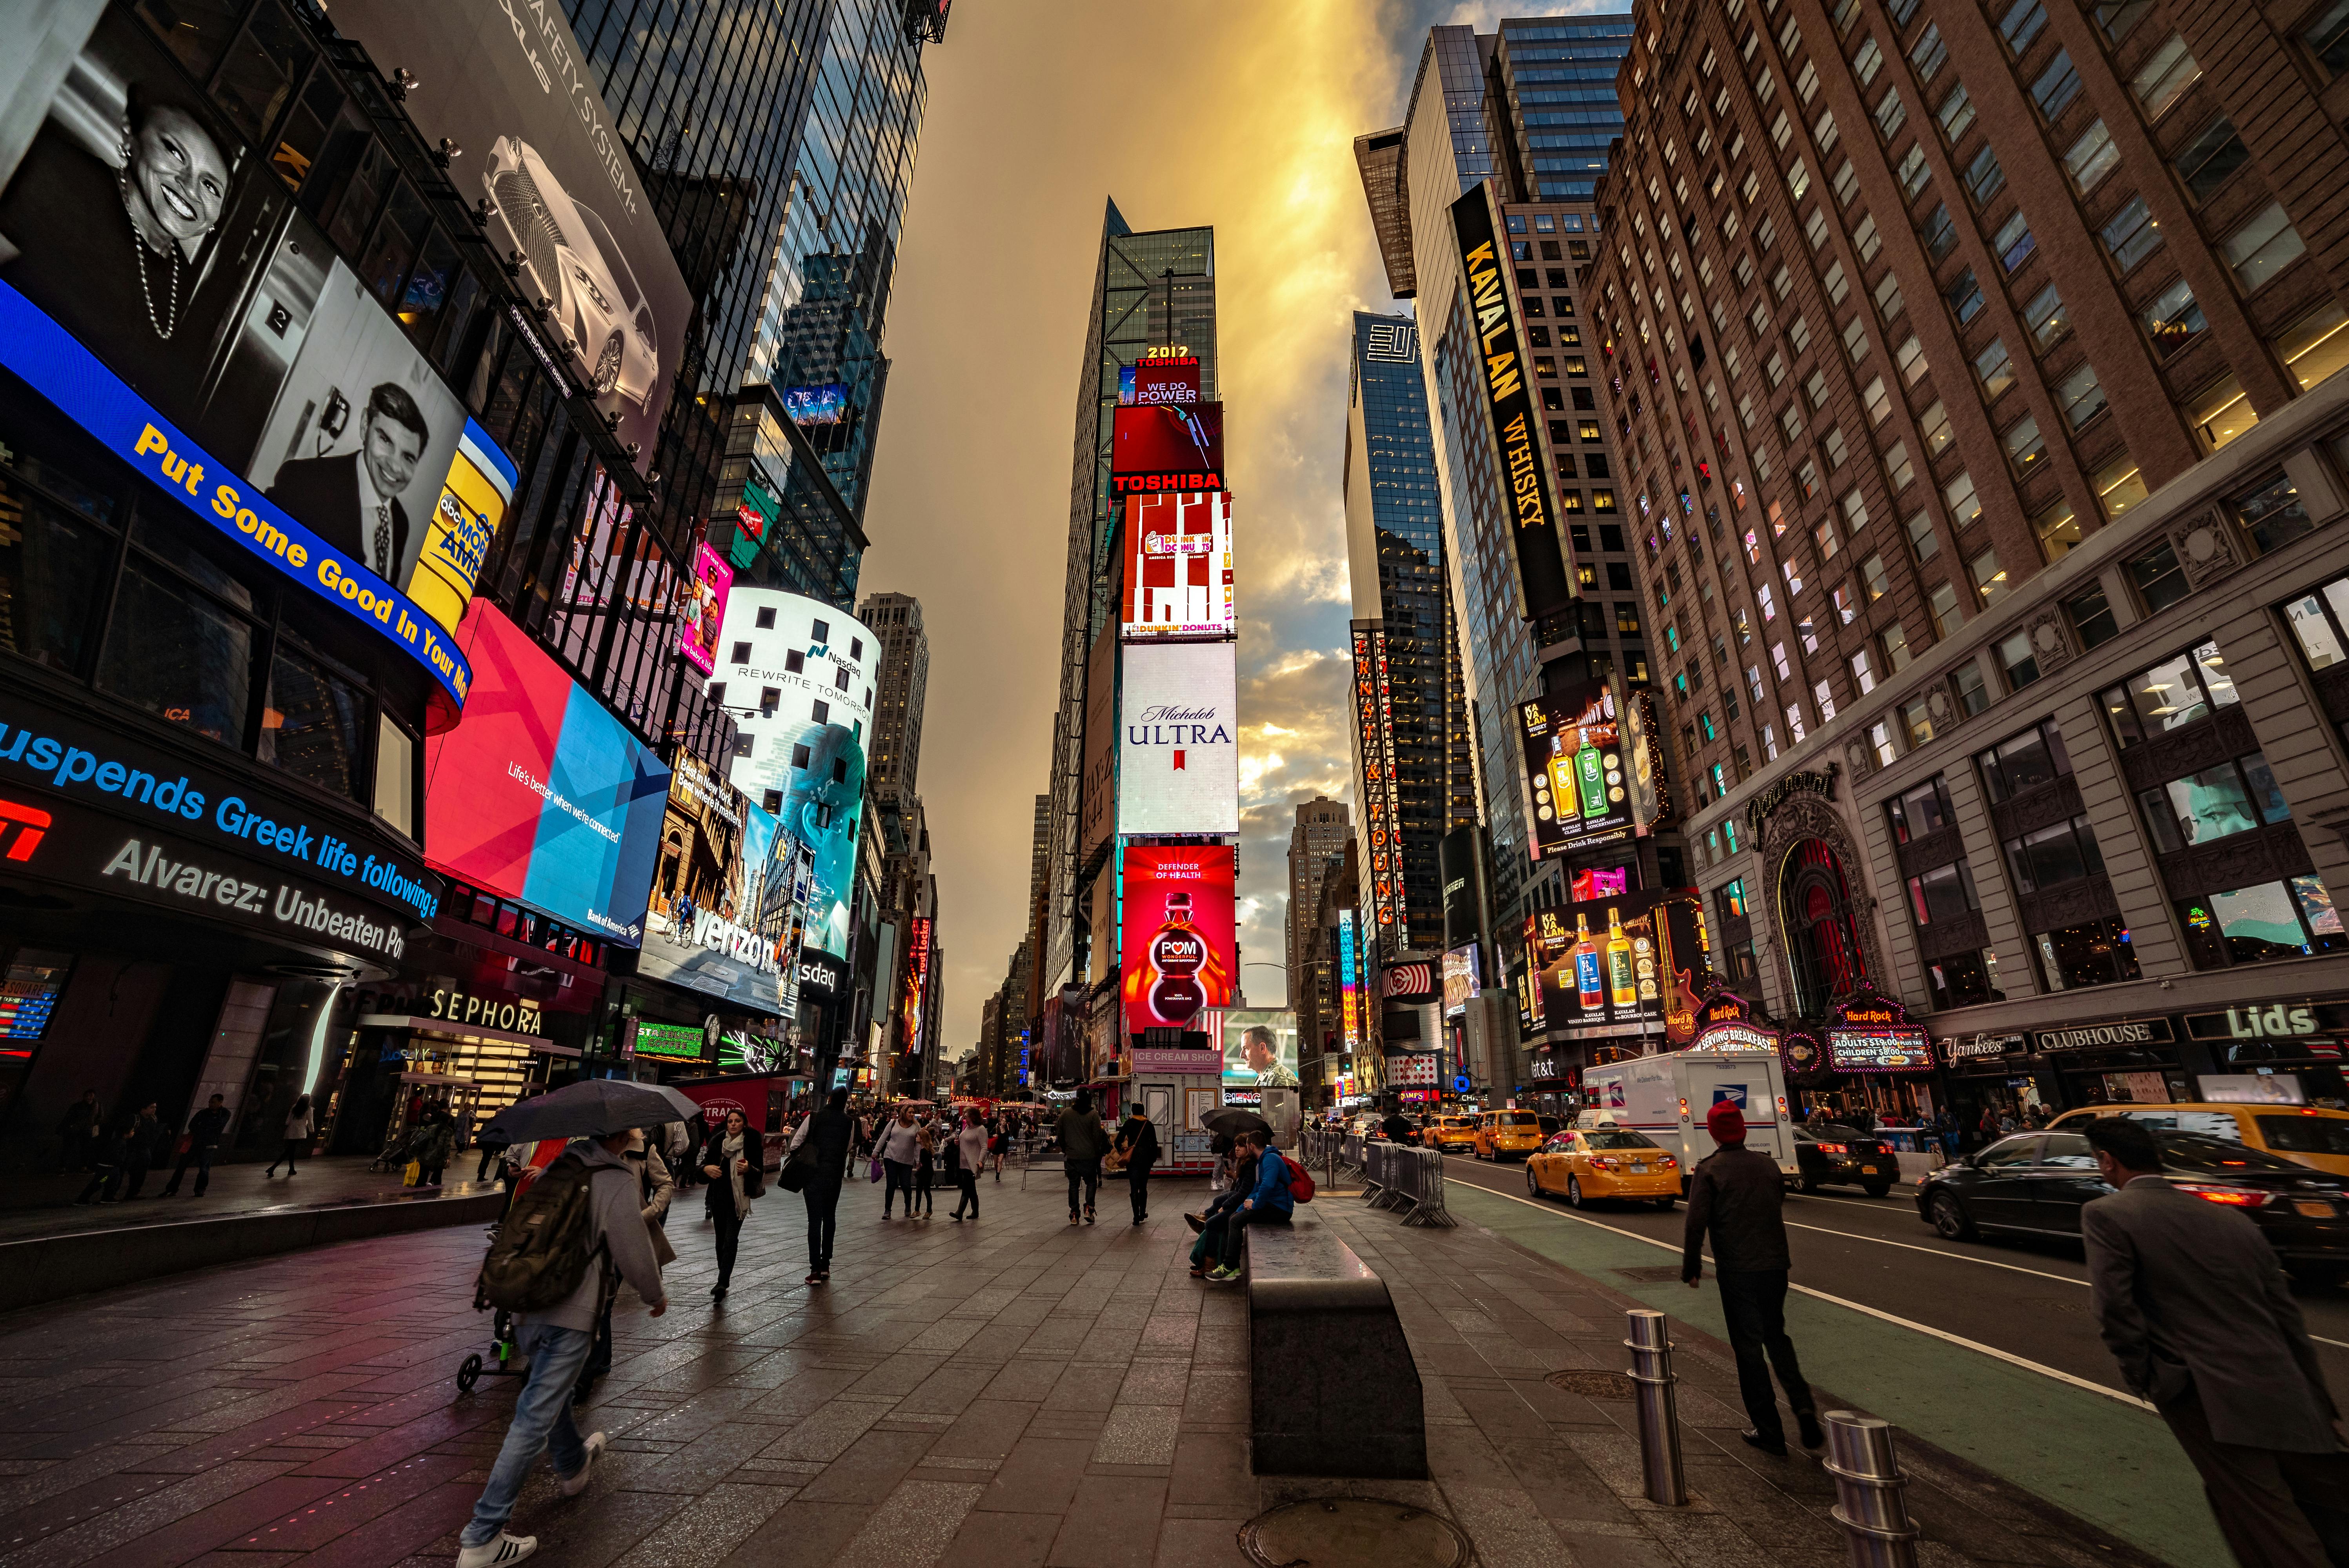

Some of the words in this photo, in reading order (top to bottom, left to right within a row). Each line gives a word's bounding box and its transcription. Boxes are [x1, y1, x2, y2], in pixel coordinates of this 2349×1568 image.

[527, 0, 584, 95] AFETY
[581, 96, 636, 214] SYSTEM+
[1137, 357, 1198, 367] TOSHIBA
[1148, 346, 1188, 358] 2017
[1466, 240, 1521, 402] KAVALAN
[1504, 412, 1545, 529] WHISKY
[1138, 390, 1196, 401] POWER
[1114, 473, 1221, 491] TOSHIBA
[440, 499, 460, 523] abc
[134, 422, 205, 496] Put
[211, 485, 307, 568] Some
[318, 558, 394, 624] Good
[396, 609, 418, 644] In
[423, 628, 454, 678] Your
[710, 555, 719, 567] test
[719, 565, 729, 577] may
[690, 646, 705, 664] baby's
[704, 659, 713, 673] life.
[828, 652, 861, 679] Nasdaq
[738, 668, 811, 689] REWRITE
[1357, 640, 1373, 740] ERNST
[1141, 706, 1217, 722] Michelob
[1525, 704, 1538, 713] KA
[1526, 711, 1539, 720] VA
[1527, 715, 1547, 727] LAN
[1528, 723, 1547, 732] WHISKY
[1128, 724, 1232, 745] ULTRA
[681, 757, 697, 780] Best
[697, 769, 704, 784] in
[703, 775, 718, 795] New
[719, 786, 733, 807] York.
[1366, 764, 1379, 780] &
[508, 760, 529, 786] Life's
[530, 775, 553, 800] better
[554, 794, 572, 813] when
[573, 806, 589, 824] we're
[589, 818, 620, 844] connected
[678, 772, 694, 794] Best
[695, 786, 714, 808] where
[714, 799, 719, 812] it
[719, 805, 742, 828] matters.
[0, 723, 205, 820] uspends
[216, 797, 314, 860] Greek
[317, 835, 357, 877] life
[361, 855, 431, 919] following
[1586, 817, 1605, 825] KAVALAN
[1587, 817, 1625, 829] CONCERTMASTER
[1547, 842, 1567, 853] Please
[1568, 839, 1586, 849] Drink
[1587, 831, 1626, 845] Responsibly
[1370, 804, 1393, 925] YOUNG
[102, 839, 267, 913] Alvarez:
[274, 885, 394, 950] Unbeaten
[587, 908, 602, 925] Bank
[601, 916, 608, 927] of
[606, 918, 627, 936] America
[1542, 913, 1556, 922] KA
[1543, 920, 1557, 930] VA
[693, 906, 774, 973] verizon
[919, 919, 929, 950] Locker
[1544, 926, 1564, 938] LAN
[1161, 942, 1196, 955] POM
[800, 962, 835, 993] sdaq
[9, 982, 44, 997] SQUARE
[430, 989, 540, 1035] SEPHORA
[1668, 1014, 1685, 1025] Hard
[1710, 1005, 1723, 1020] Hard
[1725, 1003, 1739, 1020] Rock
[1847, 1011, 1869, 1020] Hard
[1870, 1011, 1891, 1022] Rock
[2227, 1004, 2317, 1039] Lids
[638, 1027, 698, 1040] STARBUCKS
[647, 1038, 685, 1048] COFFEE
[1702, 1030, 1728, 1050] SERVING
[1729, 1029, 1770, 1051] BREAKFAST
[1869, 1038, 1897, 1047] $19.00
[2041, 1024, 2149, 1050] CLUBHOUSE
[1154, 1053, 1188, 1061] CREAM
[1192, 1053, 1218, 1061] SHOP
[1943, 1033, 2002, 1068] Yankees
